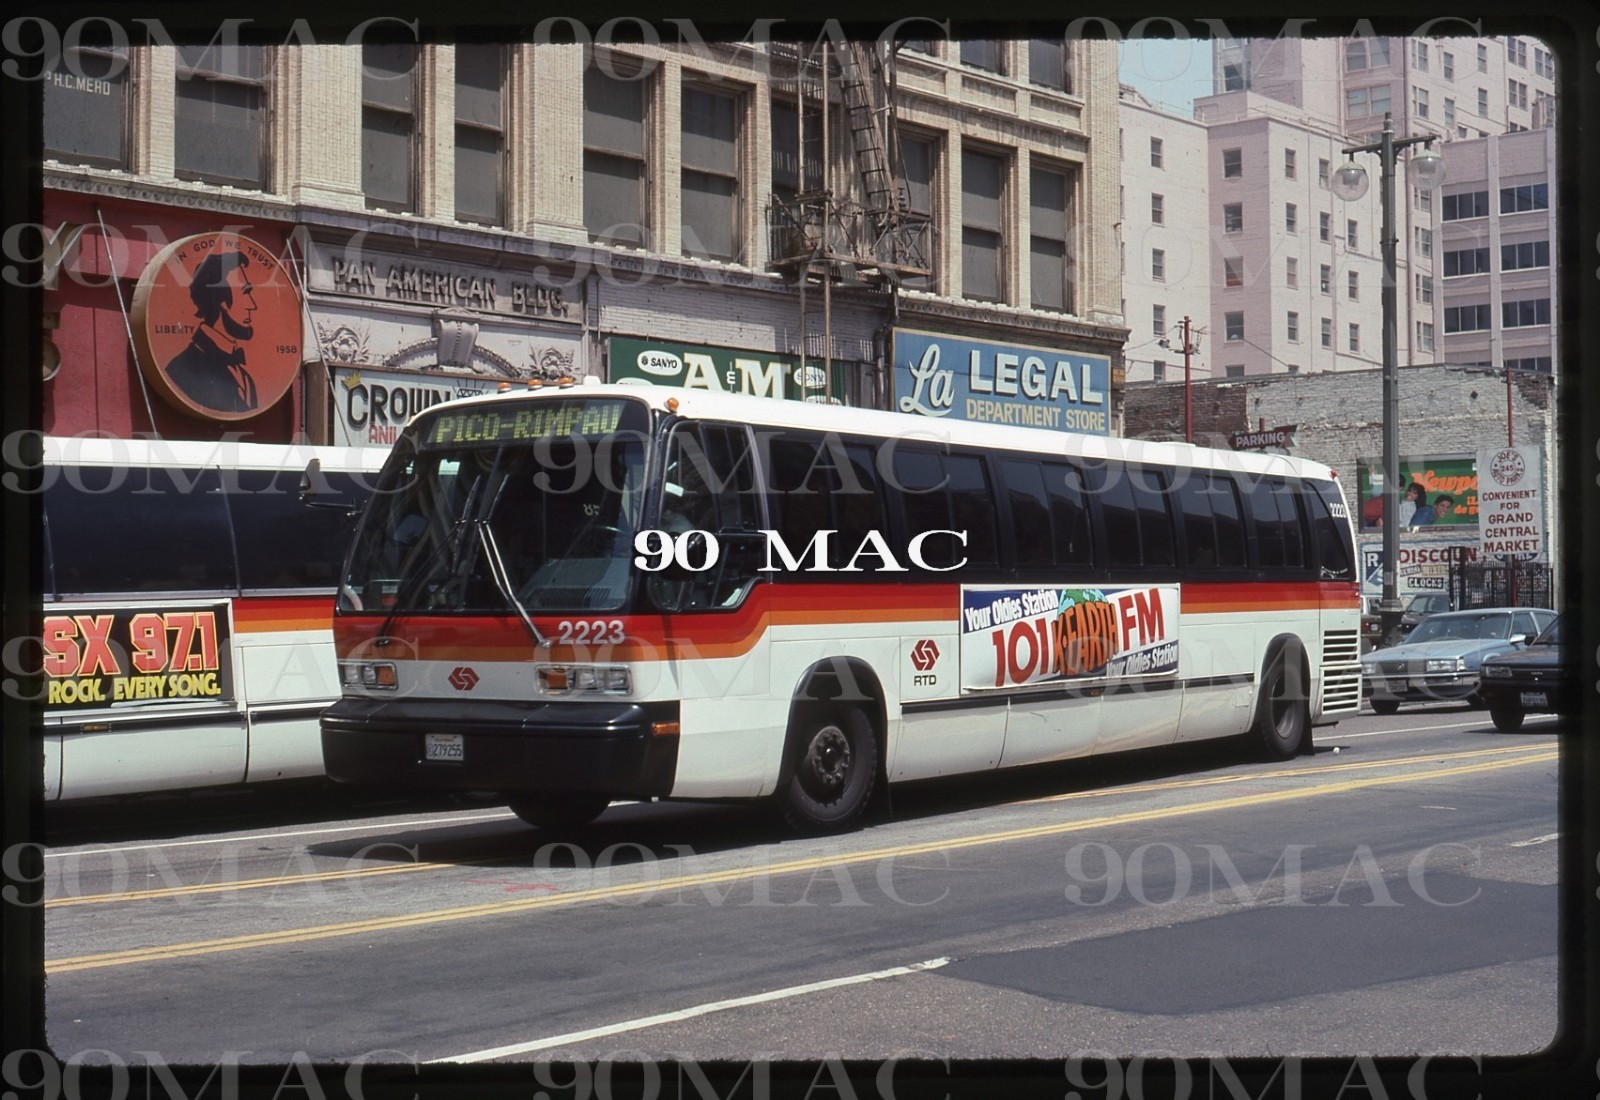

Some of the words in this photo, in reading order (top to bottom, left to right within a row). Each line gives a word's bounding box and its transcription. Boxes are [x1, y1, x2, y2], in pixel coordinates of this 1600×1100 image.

[193, 240, 216, 252] GOD
[225, 240, 241, 249] WE
[247, 246, 275, 270] TRUST
[333, 257, 376, 287] PAN
[386, 265, 498, 303] AMERICAN
[512, 281, 569, 311] BLDG.
[155, 325, 195, 334] LIBERTY
[276, 345, 298, 354] 1958
[650, 358, 678, 369] SANYO
[900, 343, 955, 417] La
[970, 349, 1104, 404] LEGAL
[966, 398, 1061, 428] DEPARTMENT
[1065, 409, 1106, 432] STORE
[436, 404, 621, 443] PICO-RIMPAU
[1236, 432, 1286, 447] PARKING
[1498, 452, 1519, 463] JOE'S
[1482, 490, 1537, 501] CONVENIENT
[1500, 502, 1520, 510] FOR
[1488, 512, 1533, 524] GRAND
[1485, 526, 1539, 538] CENTRAL
[1484, 540, 1539, 553] MARKET
[1399, 547, 1485, 564] DISCOUN
[1408, 577, 1443, 588] CLOCKS
[965, 606, 991, 632] Your
[992, 597, 1022, 623] Oldies
[1022, 589, 1059, 616] Station
[558, 620, 625, 645] 2223
[992, 617, 1050, 687] 101
[1118, 588, 1165, 651] FM
[43, 615, 121, 677] SX
[129, 612, 219, 673] 97.1
[1106, 659, 1126, 677] Your
[1126, 651, 1151, 676] Oldies
[1151, 643, 1179, 670] Station
[48, 679, 106, 704] ROCK.
[114, 675, 167, 700] EVERY
[168, 673, 221, 697] SONG.
[914, 675, 937, 686] RTD
